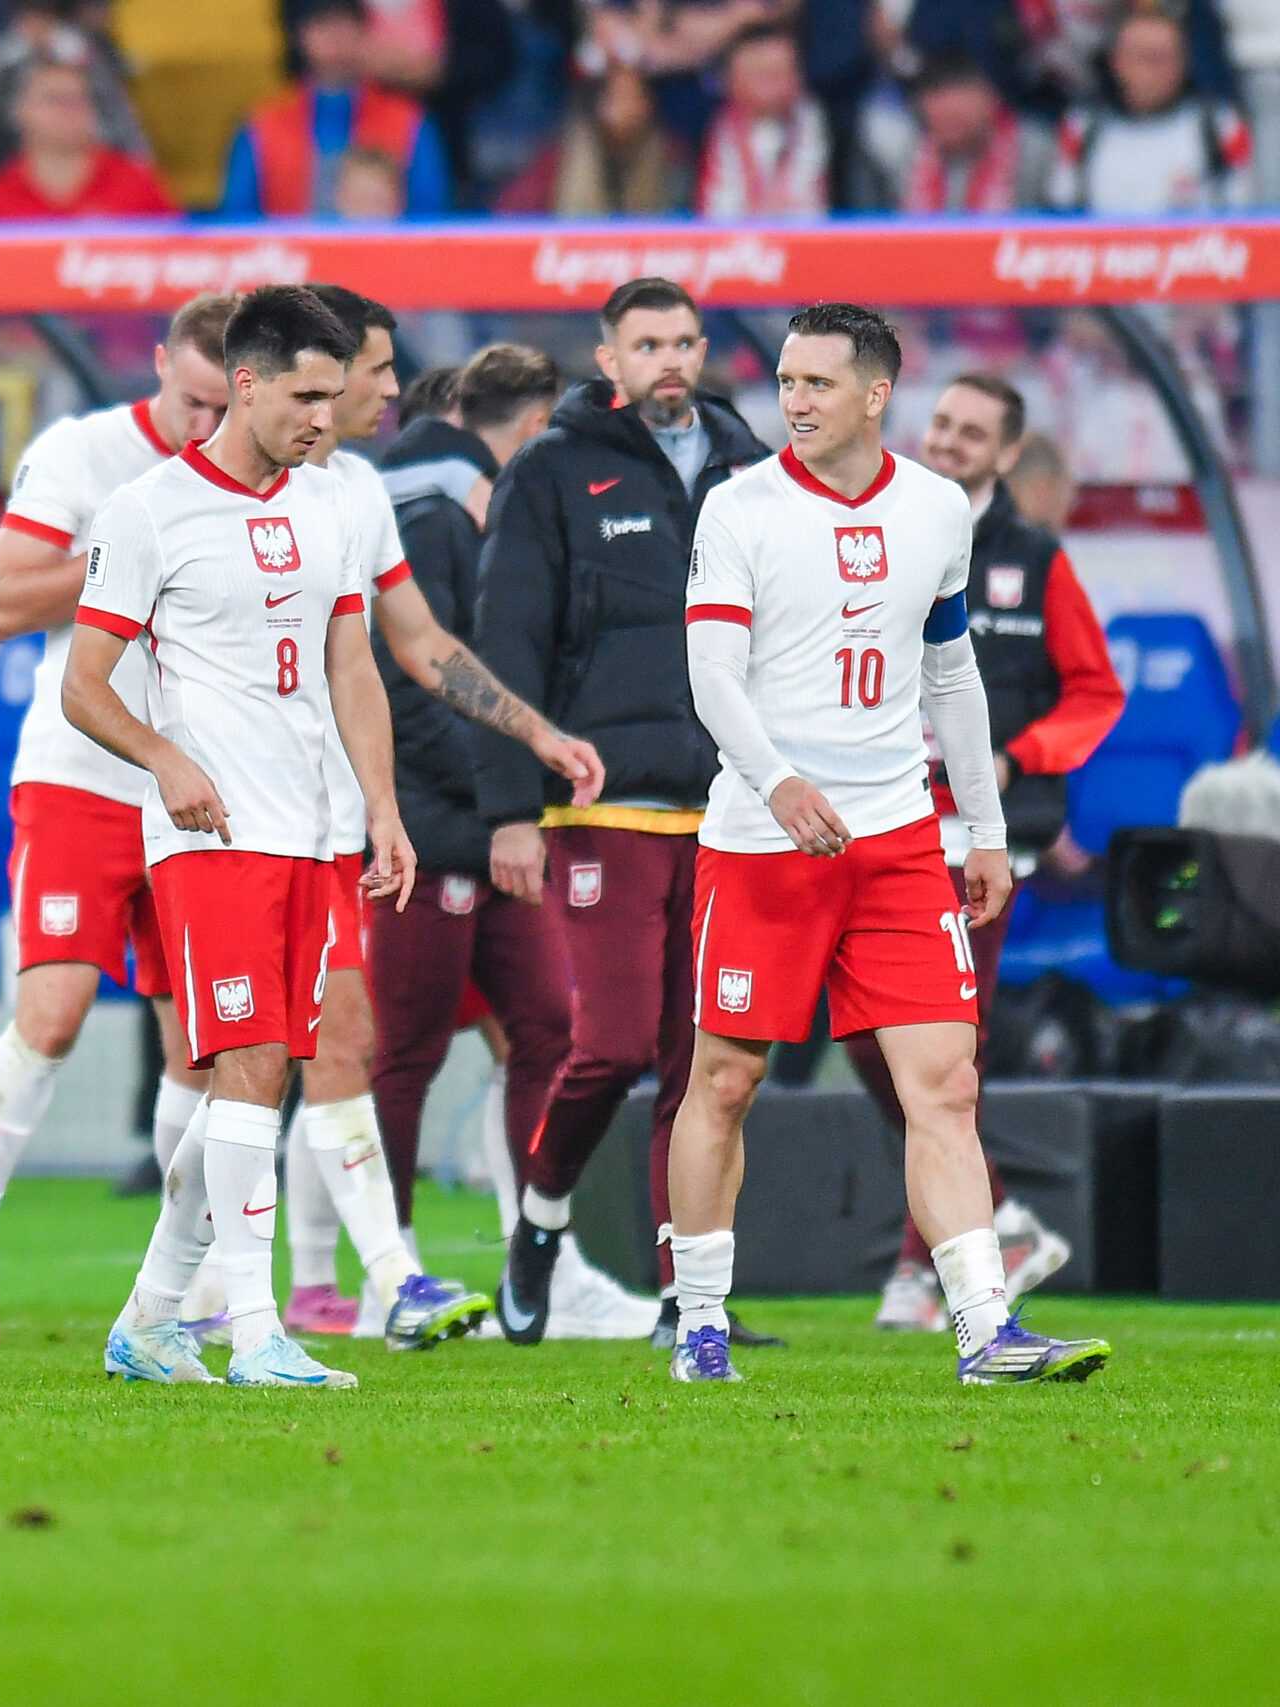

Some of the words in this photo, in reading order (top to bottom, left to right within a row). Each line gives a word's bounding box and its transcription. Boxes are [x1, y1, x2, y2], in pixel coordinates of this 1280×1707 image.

[614, 520, 651, 535] InPost
[277, 637, 300, 698] 8
[835, 648, 886, 710] 10
